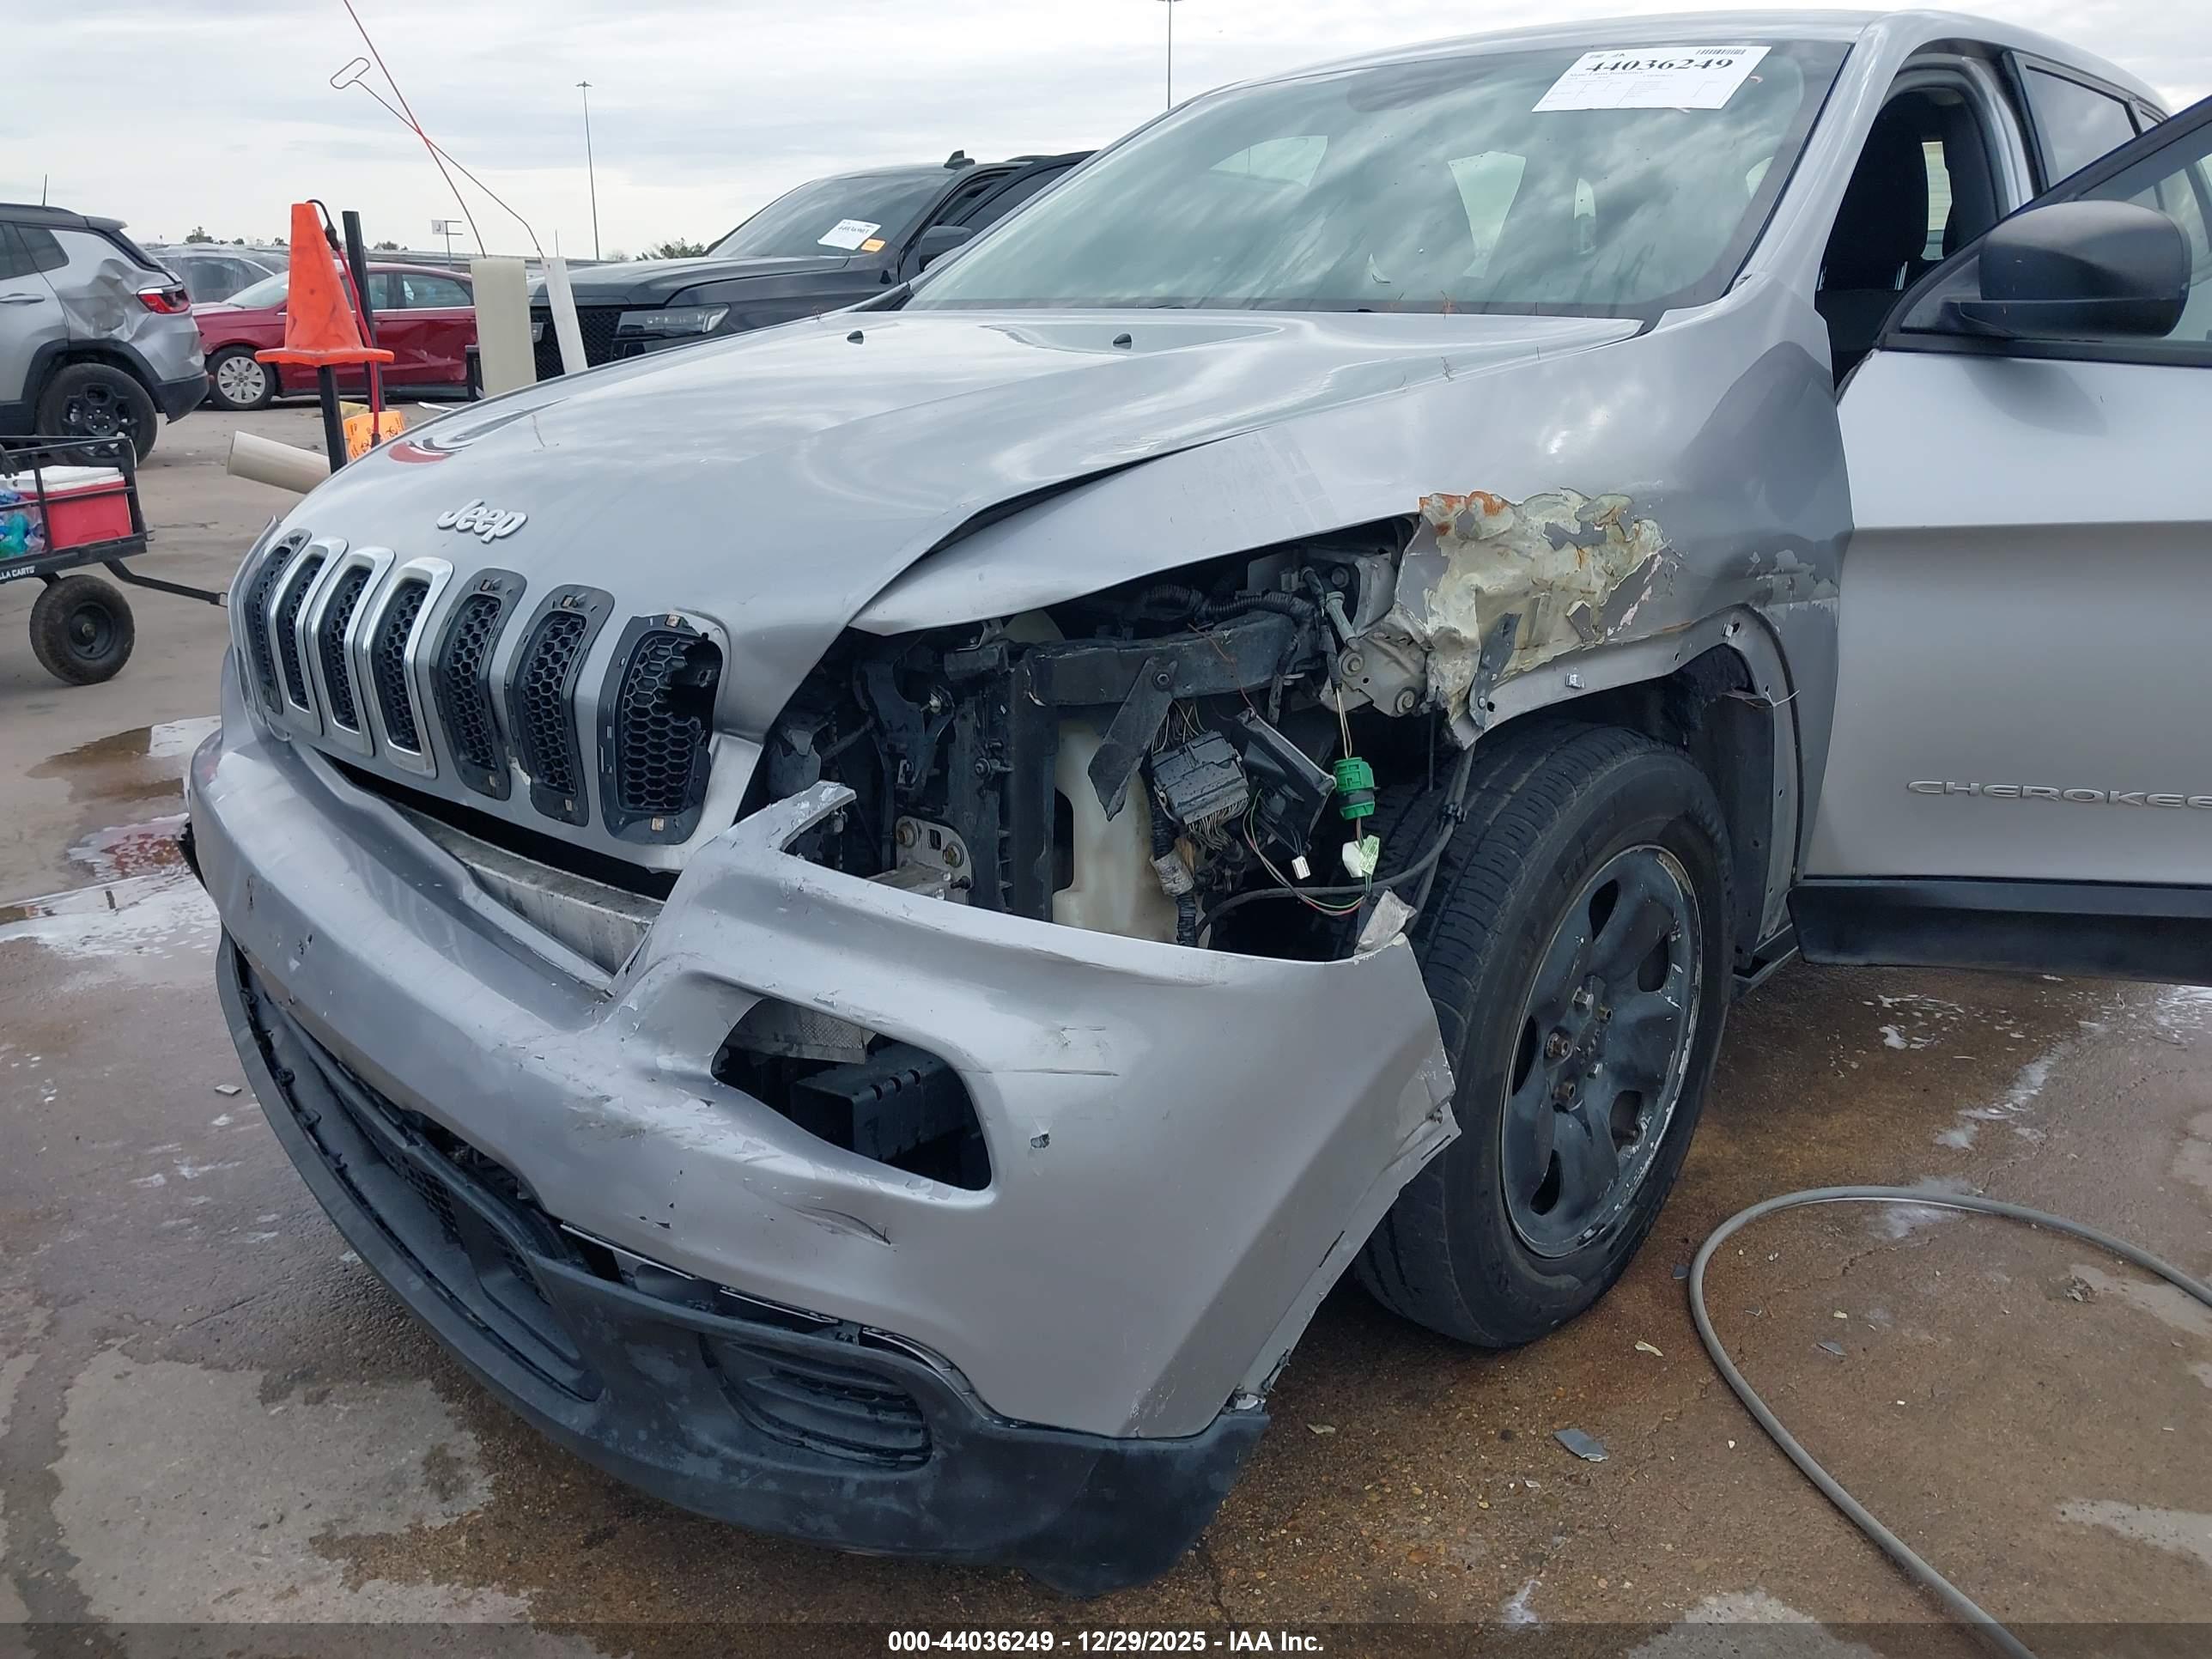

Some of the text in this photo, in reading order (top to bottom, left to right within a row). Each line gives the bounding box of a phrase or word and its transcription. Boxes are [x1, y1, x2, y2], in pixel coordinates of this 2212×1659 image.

[1585, 58, 1734, 71] 44036249
[437, 498, 528, 544] Jeep
[1907, 780, 2212, 809] CHEROKEE
